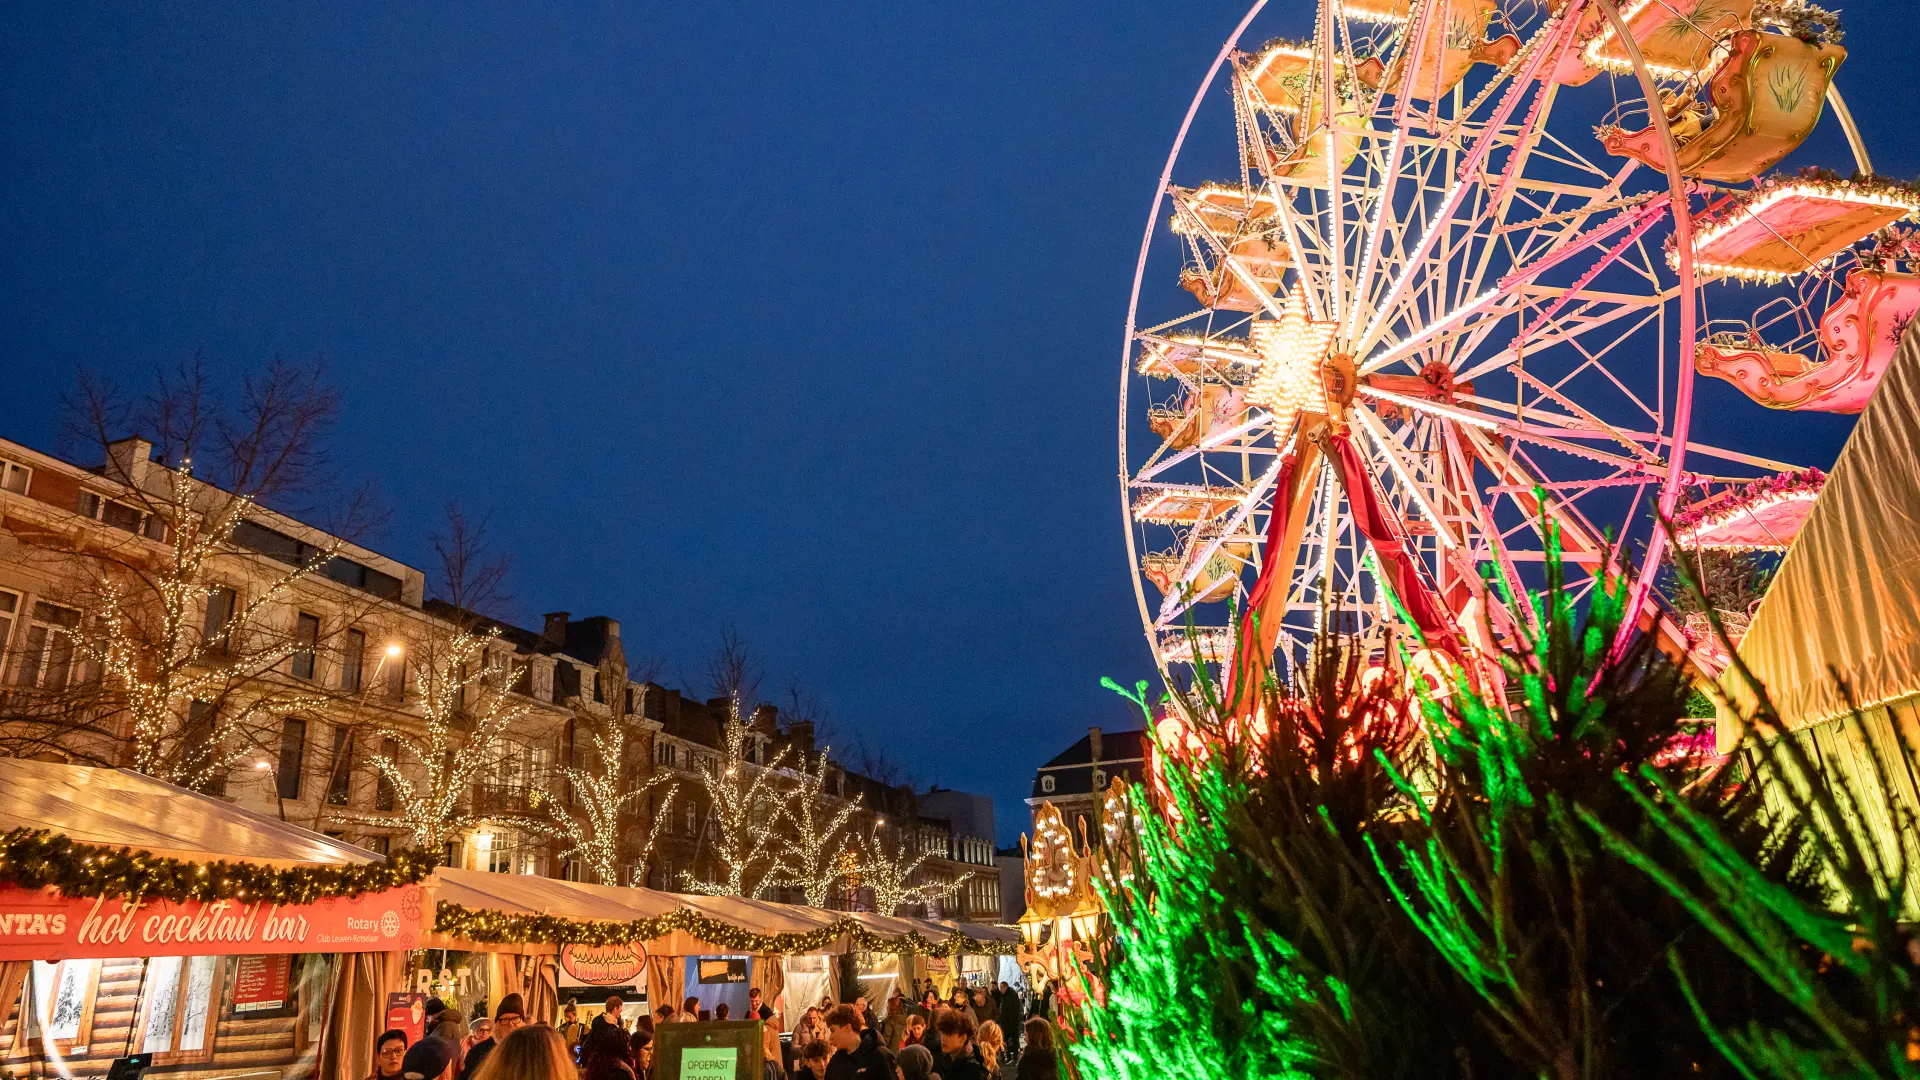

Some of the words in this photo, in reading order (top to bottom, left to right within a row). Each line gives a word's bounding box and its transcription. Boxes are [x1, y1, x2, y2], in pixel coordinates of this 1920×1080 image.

[1833, 325, 1841, 334] 9
[77, 892, 147, 944] hot
[142, 900, 258, 943] cocktail
[262, 903, 310, 942] bar
[347, 917, 379, 932] Rotary
[316, 935, 331, 943] Club
[331, 934, 379, 943] Leuven-Rotselaar
[687, 1060, 729, 1070] OPGEPAST
